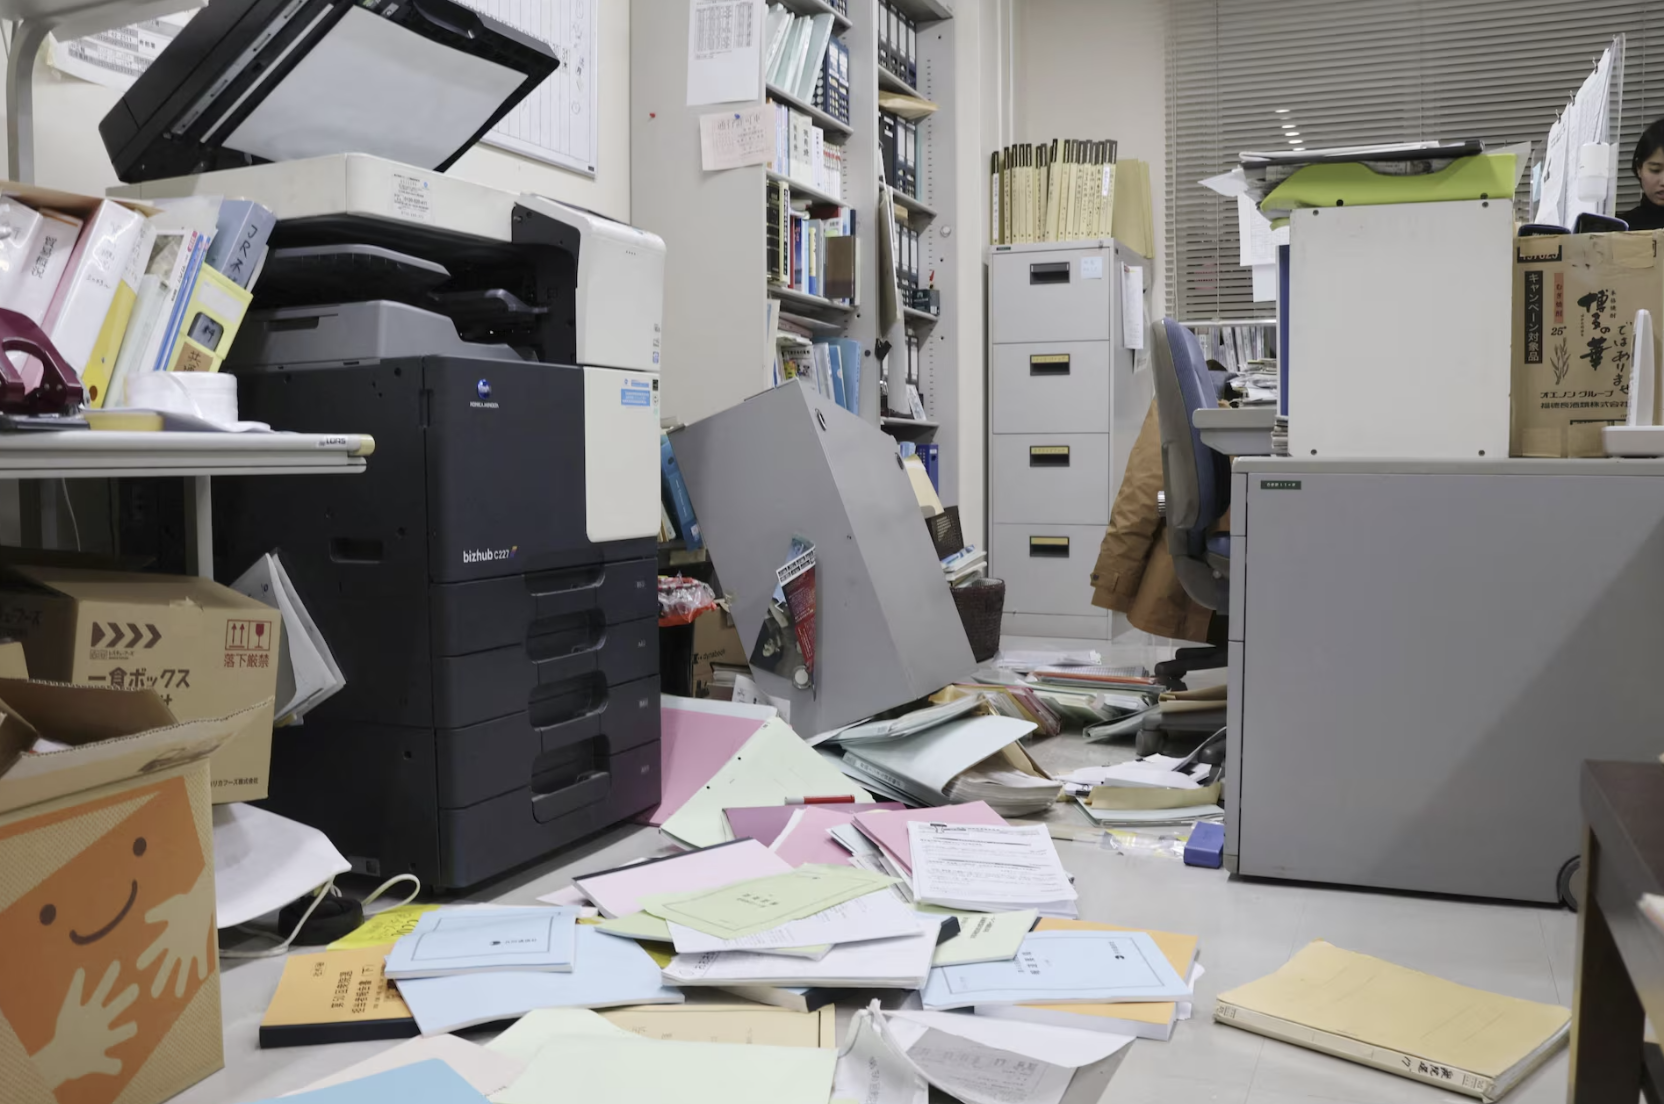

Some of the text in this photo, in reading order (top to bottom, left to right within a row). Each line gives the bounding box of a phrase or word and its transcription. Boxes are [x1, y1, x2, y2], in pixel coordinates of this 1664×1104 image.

[1527, 273, 1540, 362] キャンペーン対象品
[1577, 288, 1613, 371] 博多の華
[1540, 390, 1614, 399] オエノン グループ
[463, 548, 510, 563] bizhub C227
[224, 653, 270, 668] 落下厳禁
[88, 667, 191, 689] 一食ボックス
